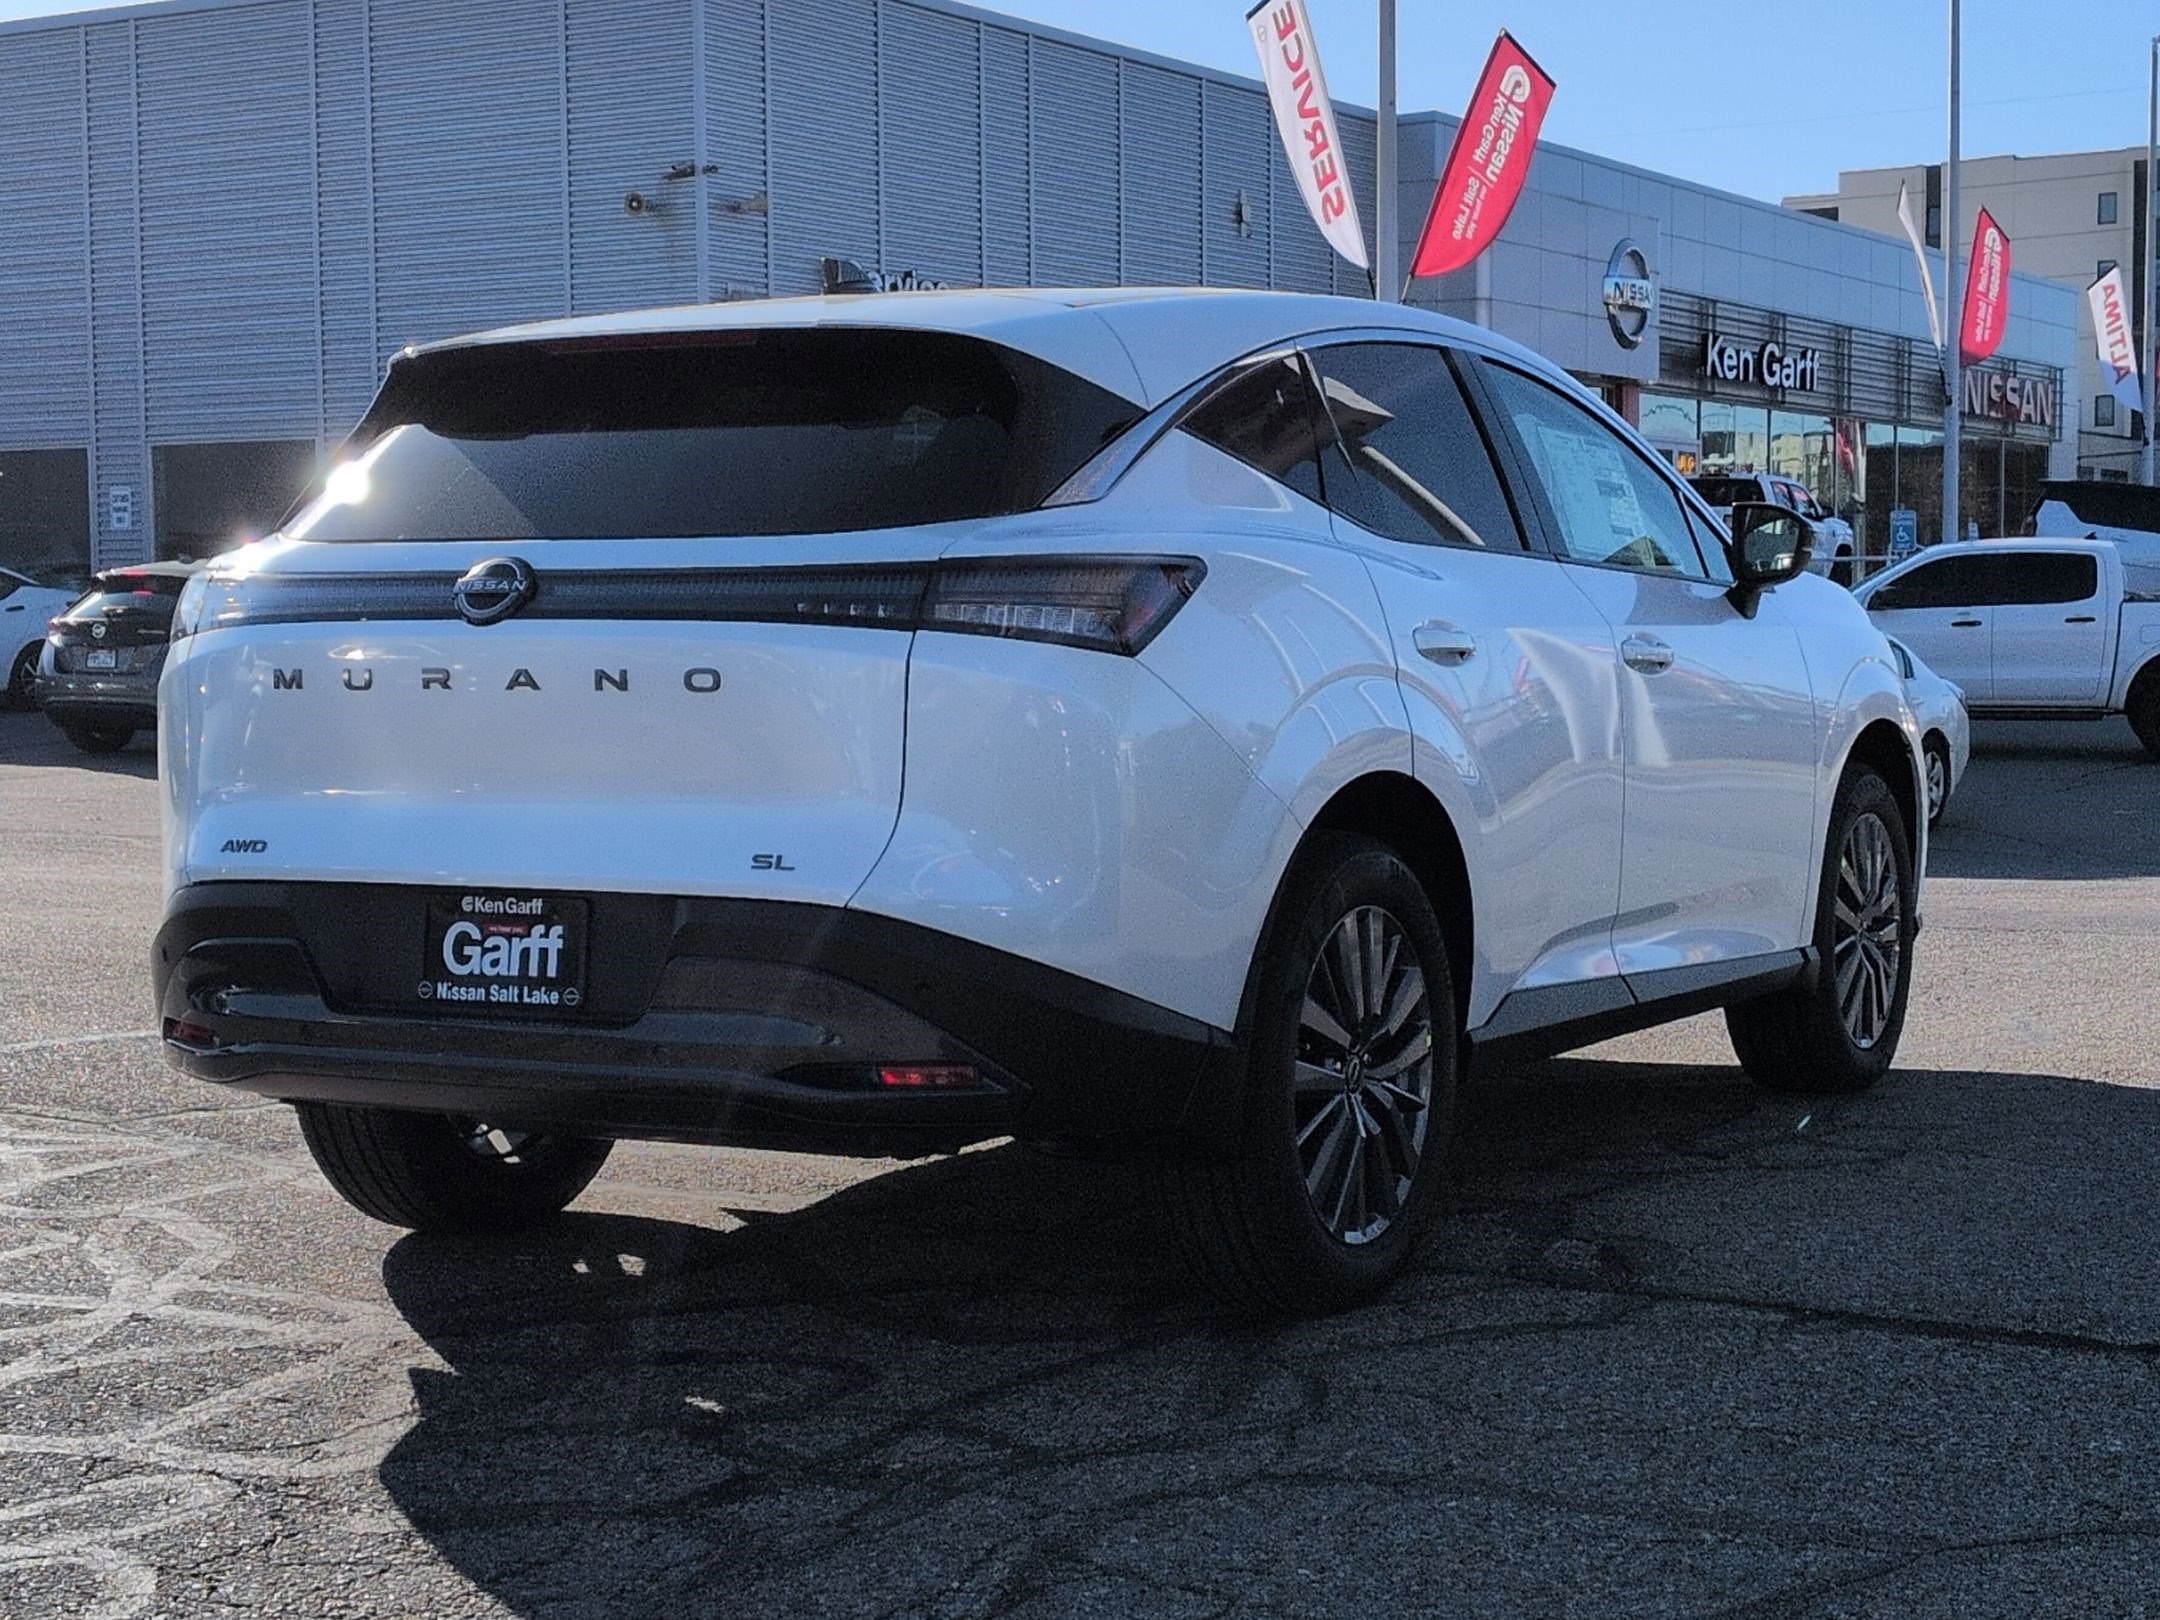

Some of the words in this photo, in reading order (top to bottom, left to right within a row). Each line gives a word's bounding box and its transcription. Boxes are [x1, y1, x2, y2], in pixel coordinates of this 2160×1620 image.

[1613, 281, 1653, 306] NISSA
[1706, 333, 1755, 383] Ken
[1762, 342, 1821, 392] Garff
[1963, 369, 2054, 426] NISSAN
[454, 579, 527, 592] NISSAN
[273, 668, 723, 692] MURANO
[220, 838, 268, 854] AWD
[750, 853, 796, 872] SL
[474, 896, 504, 914] Ken
[505, 897, 543, 915] Garff
[442, 920, 564, 978] Garff
[437, 981, 486, 1001] Nissan
[489, 984, 519, 1003] Salt
[523, 986, 559, 1005] Lake
